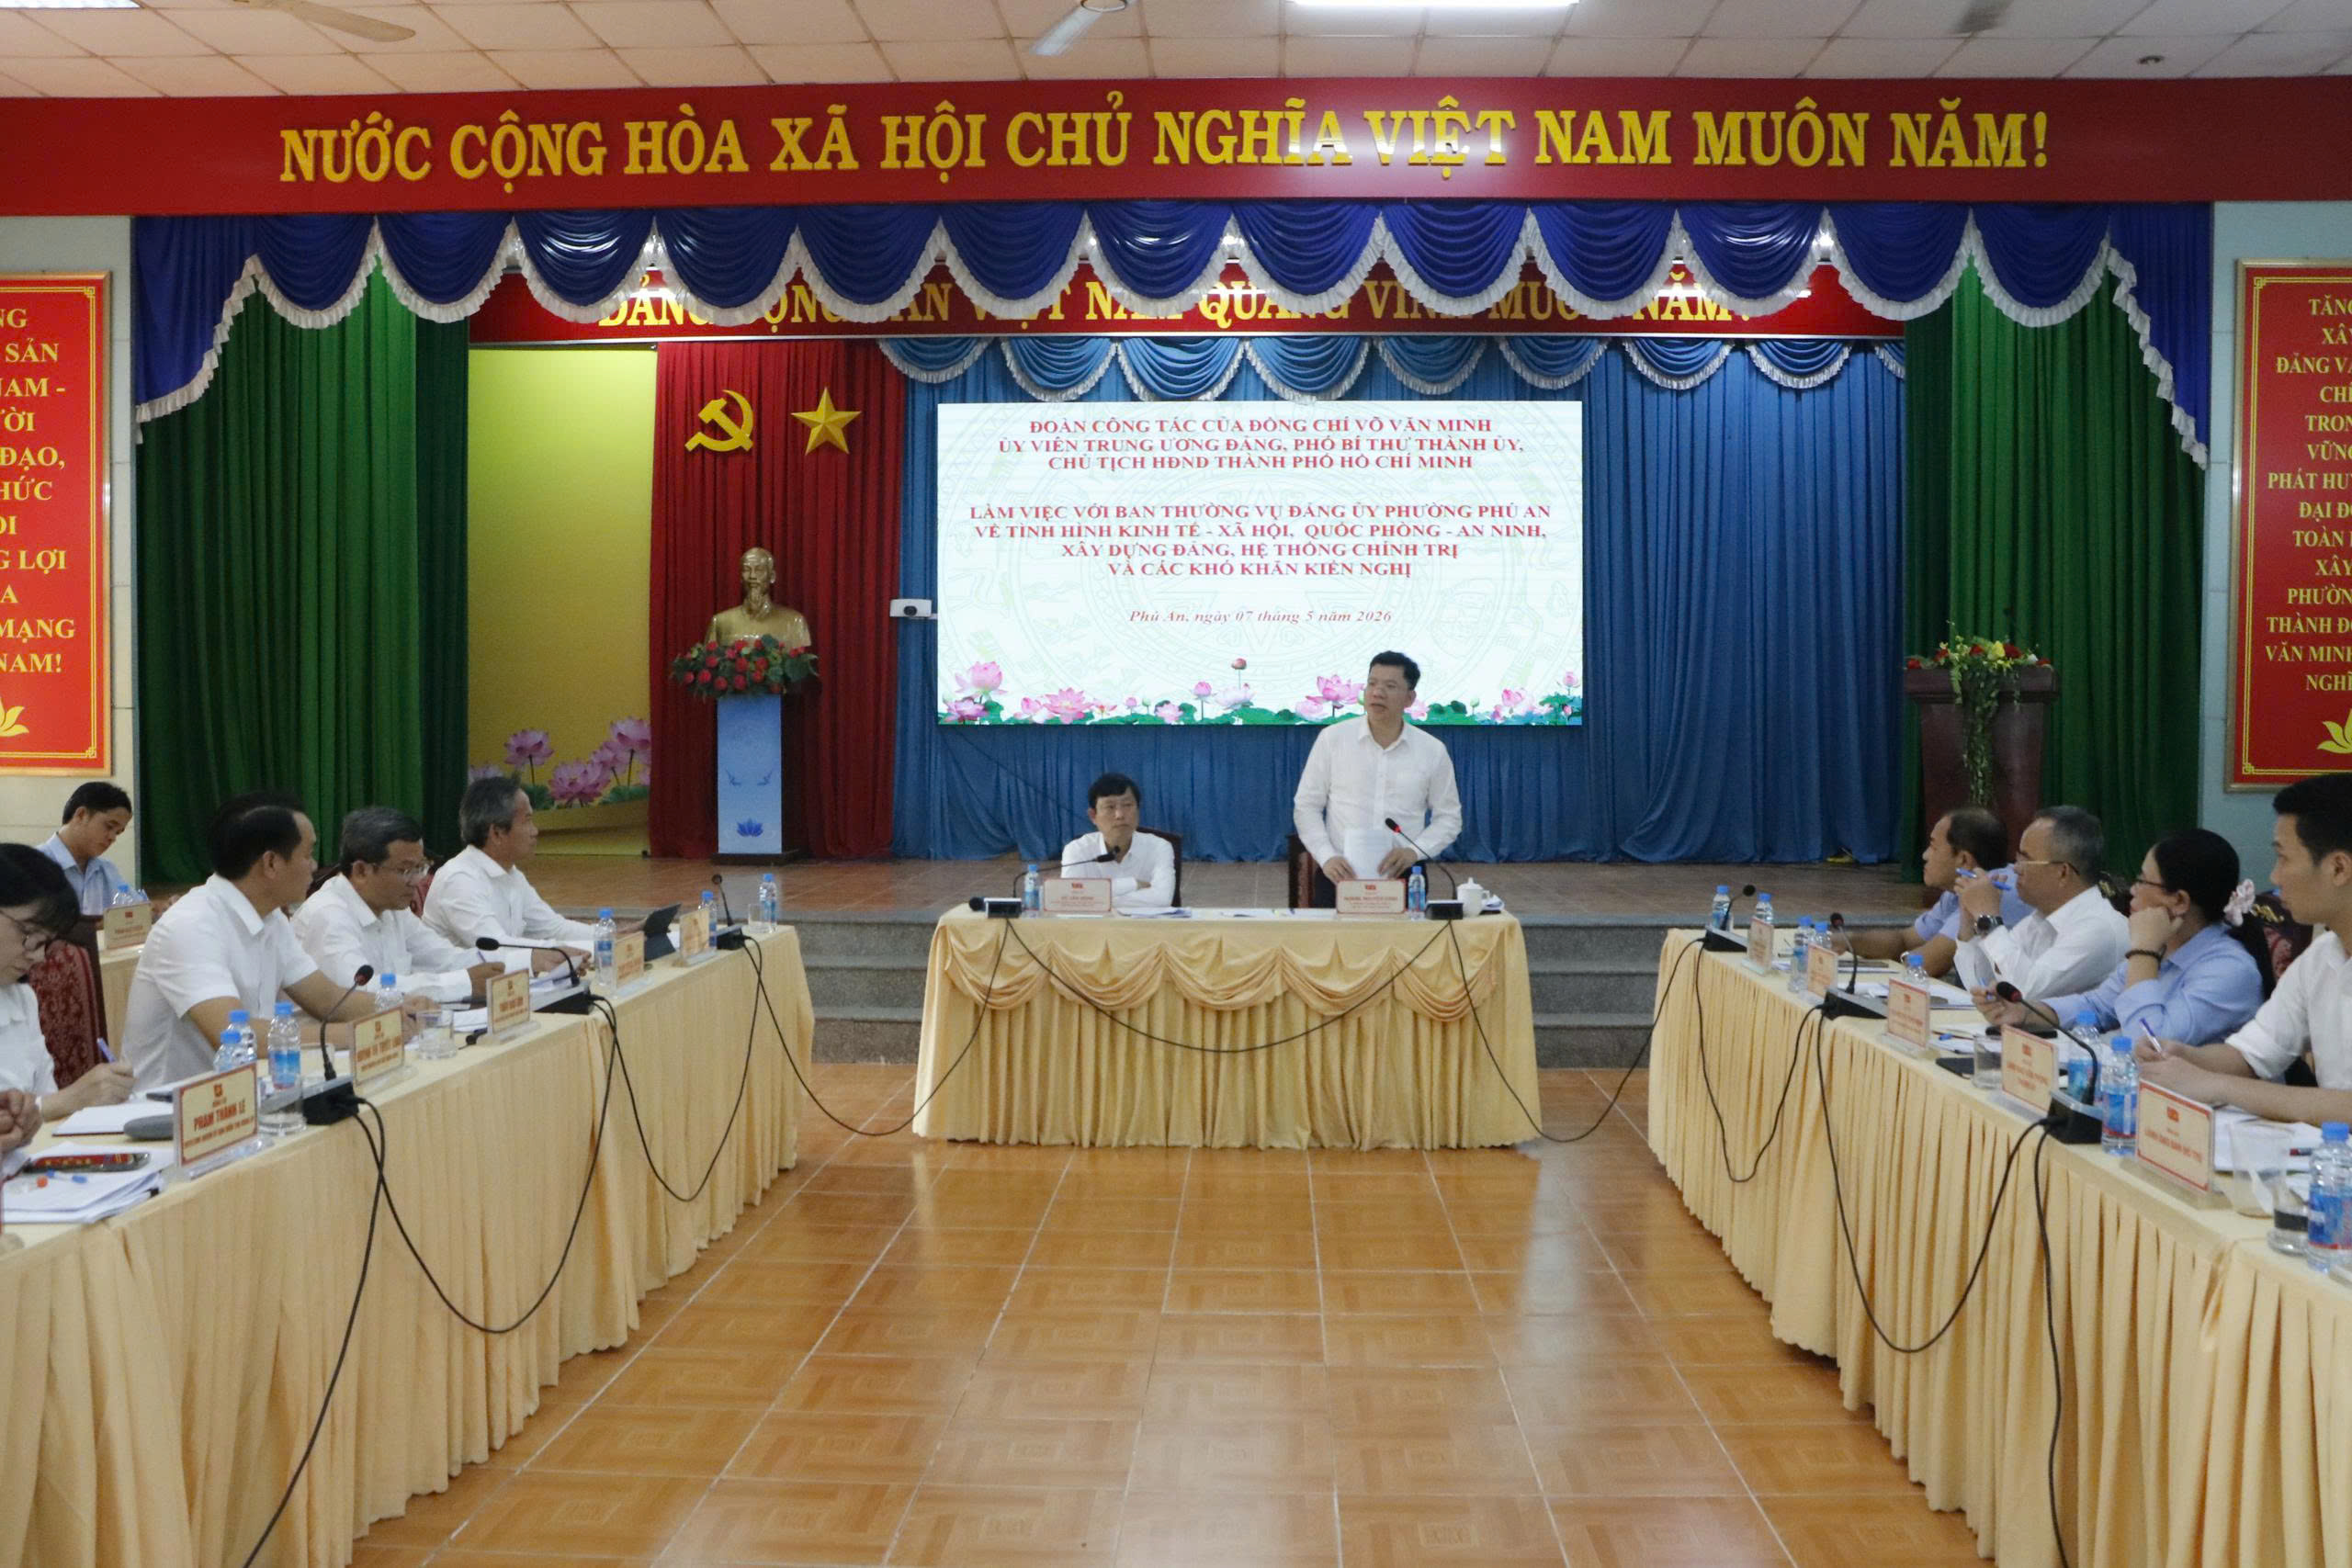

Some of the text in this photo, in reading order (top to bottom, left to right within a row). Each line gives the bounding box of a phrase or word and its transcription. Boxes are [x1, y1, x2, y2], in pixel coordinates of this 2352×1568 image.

[279, 90, 2048, 194] NƯỚC CỘNG HÒA XÃ HỘI CHỦ NGHĨA VIỆT NAM MUÔN NĂM!
[6, 337, 60, 364] SẢN
[1030, 418, 1086, 434] ĐOÀN
[1091, 416, 1150, 433] CÔNG
[1155, 416, 1195, 433] TÁC
[1249, 416, 1307, 433] ĐỒNG
[1312, 415, 1349, 432] CHÍ
[1354, 415, 1385, 433] VÕ
[1388, 416, 1430, 432] VĂN
[1437, 419, 1492, 433] MINH
[999, 434, 1524, 453] ỦY VIÊN TRUNG ƯƠNG ĐẢNG, PHÓ BÍ THƯ THÀNH ỦY,
[1047, 452, 1473, 471] CHỦ TỊCH HĐND THÀNH PHỐ HỒ CHÍ MINH
[2267, 467, 2319, 490] PHÁT
[970, 502, 1551, 522] LÀM VIỆC VỚI BAN THƯỜNG VỤ ĐẢNG ỦY PHƯỜNG PHÚ AN
[2300, 502, 2332, 522] ĐẠI
[1006, 523, 1055, 538] TÌNH
[1061, 523, 1112, 538] HÌNH
[1118, 525, 1170, 537] KINH
[1218, 522, 1246, 537] XÃ
[1251, 523, 1295, 540] HỘI,
[1304, 521, 1363, 540] QUỐC
[1370, 521, 1441, 537] PHÒNG
[1457, 525, 1484, 537] AN
[1490, 525, 1546, 539] NINH,
[2293, 525, 2345, 547] TOÀN
[1062, 540, 1459, 559] XÂY DỰNG ĐẢNG, HỆ THỐNG CHÍNH TRỊ
[18, 548, 67, 575] LỢI
[1108, 559, 1136, 576] VÀ
[1140, 559, 1183, 576] CÁC
[1190, 559, 1235, 576] KHÓ
[1360, 562, 1412, 579] NGHỊ
[1129, 610, 1159, 622] Phú
[1194, 611, 1231, 626] ngày
[1235, 610, 1254, 622] 07
[1257, 610, 1300, 626] tháng
[1306, 610, 1314, 622] 5
[1318, 611, 1351, 622] năm
[1356, 610, 1393, 622] 2026
[2267, 611, 2333, 633] THÀNH
[2266, 641, 2303, 662] VĂN
